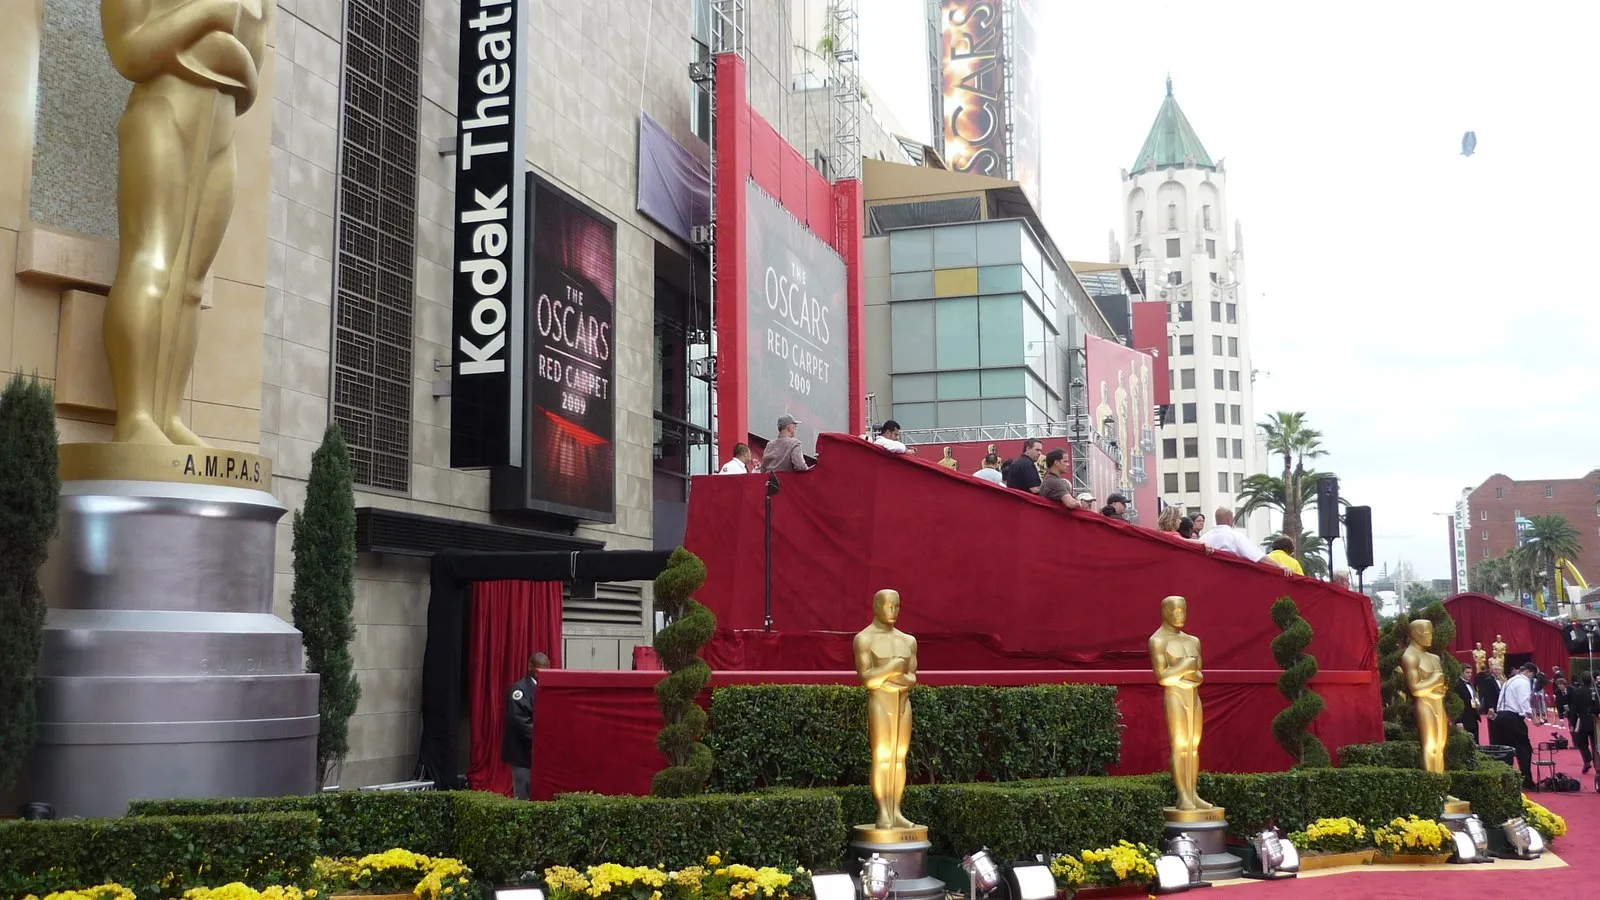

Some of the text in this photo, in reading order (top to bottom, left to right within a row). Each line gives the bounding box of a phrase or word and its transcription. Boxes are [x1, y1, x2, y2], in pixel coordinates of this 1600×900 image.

[950, 3, 1000, 176] SCARS
[459, 0, 512, 375] Kodak Theat
[566, 285, 584, 306] THE
[791, 262, 807, 285] THE
[537, 293, 609, 361] OSCARS
[765, 266, 829, 344] OSCARS
[539, 354, 609, 400] RED CARPET
[767, 328, 829, 383] RED CARPET
[789, 370, 811, 396] 2009
[561, 391, 586, 415] 2009
[1455, 510, 1467, 593] SCIENTOLO
